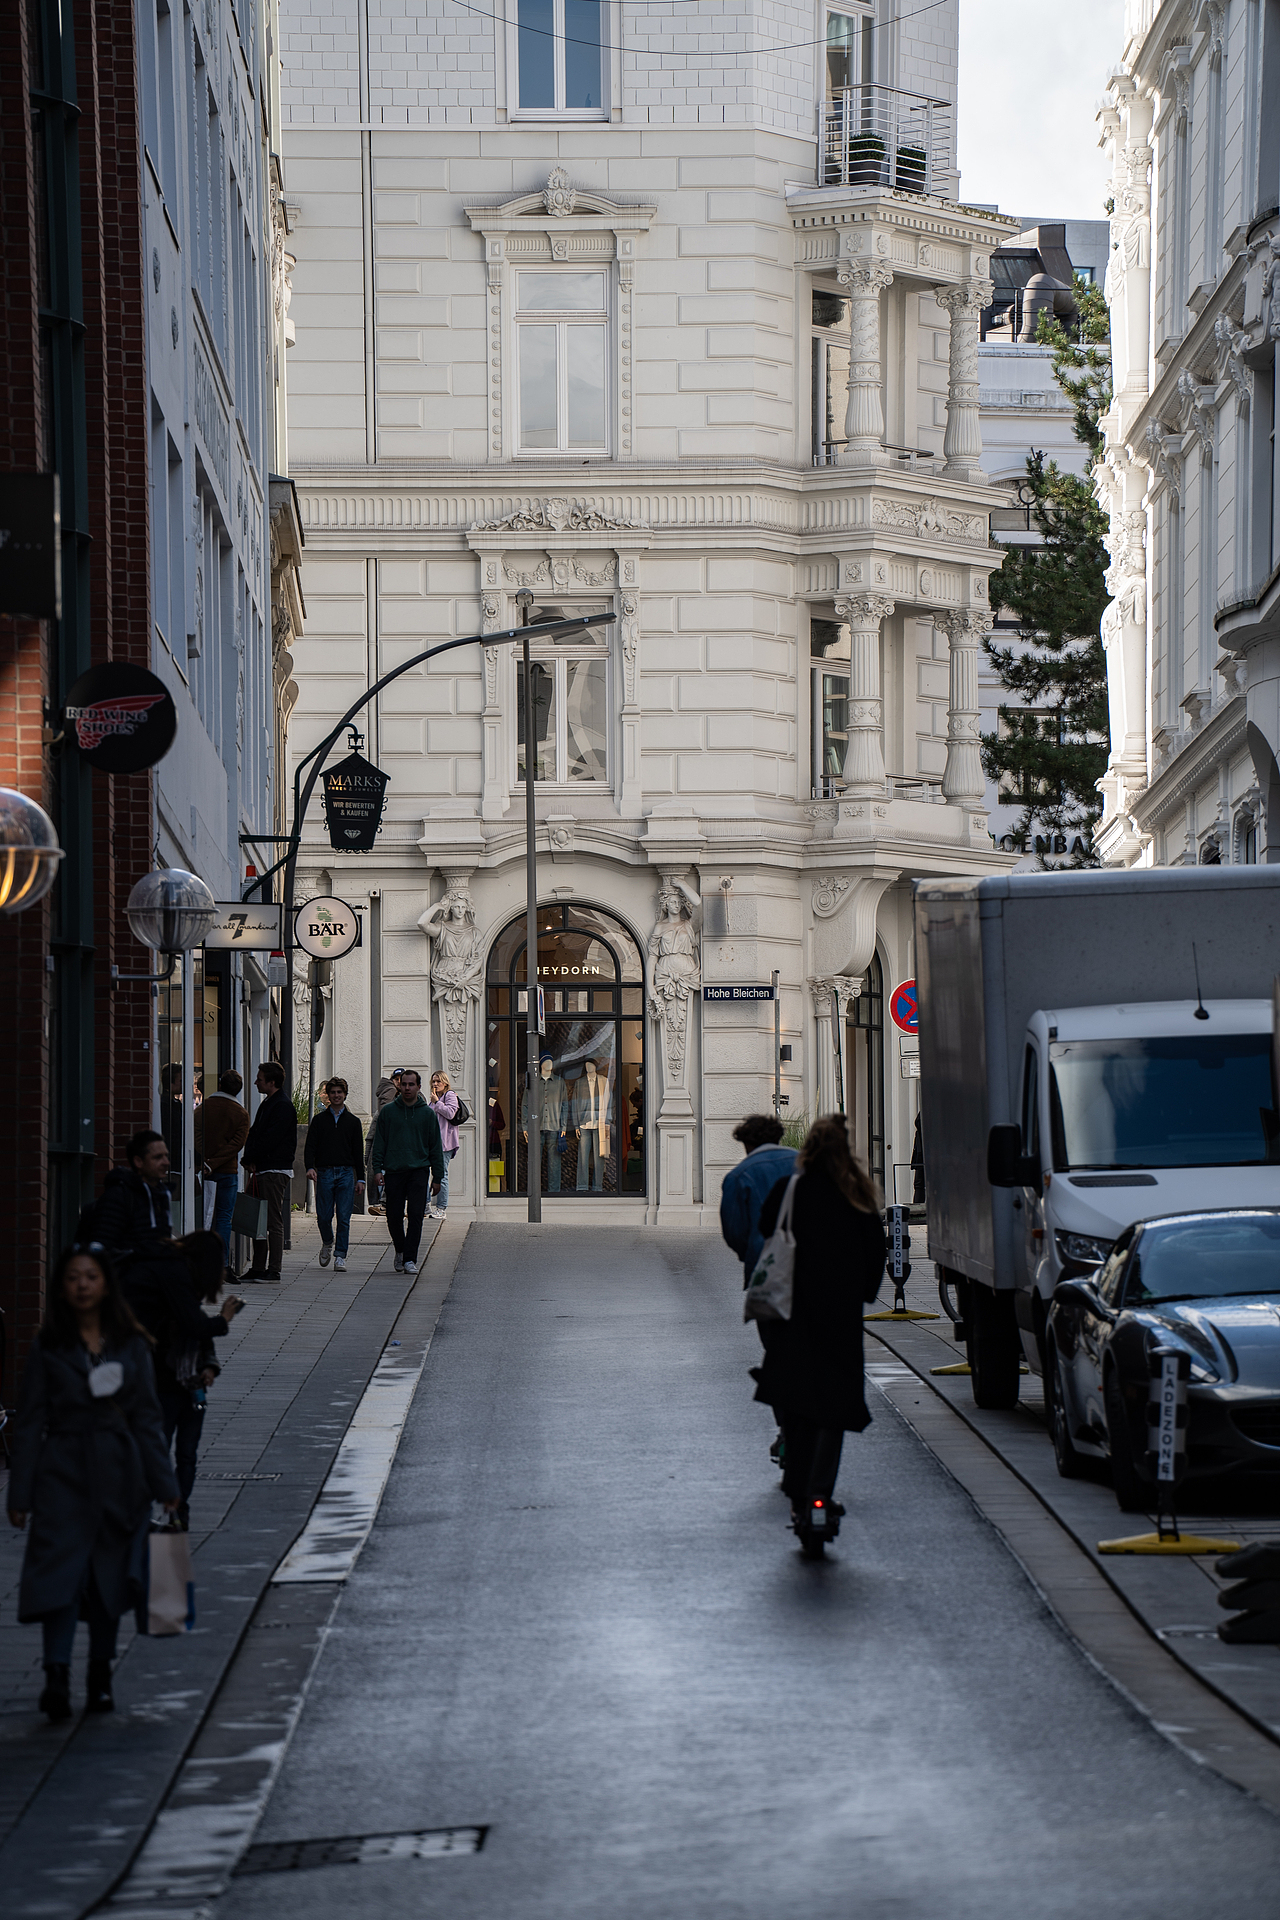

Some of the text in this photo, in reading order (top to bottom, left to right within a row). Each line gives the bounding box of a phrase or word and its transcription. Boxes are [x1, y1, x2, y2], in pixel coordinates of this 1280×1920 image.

[66, 707, 148, 723] RED WING
[82, 722, 135, 735] SHOES
[328, 774, 381, 787] MARKS
[345, 802, 375, 810] BEWERTEN
[228, 913, 248, 940] 7
[239, 922, 278, 931] mankind
[308, 922, 345, 936] BÄR
[707, 988, 770, 998] Hohe Bleichen
[1162, 1364, 1174, 1475] LADEZONE
